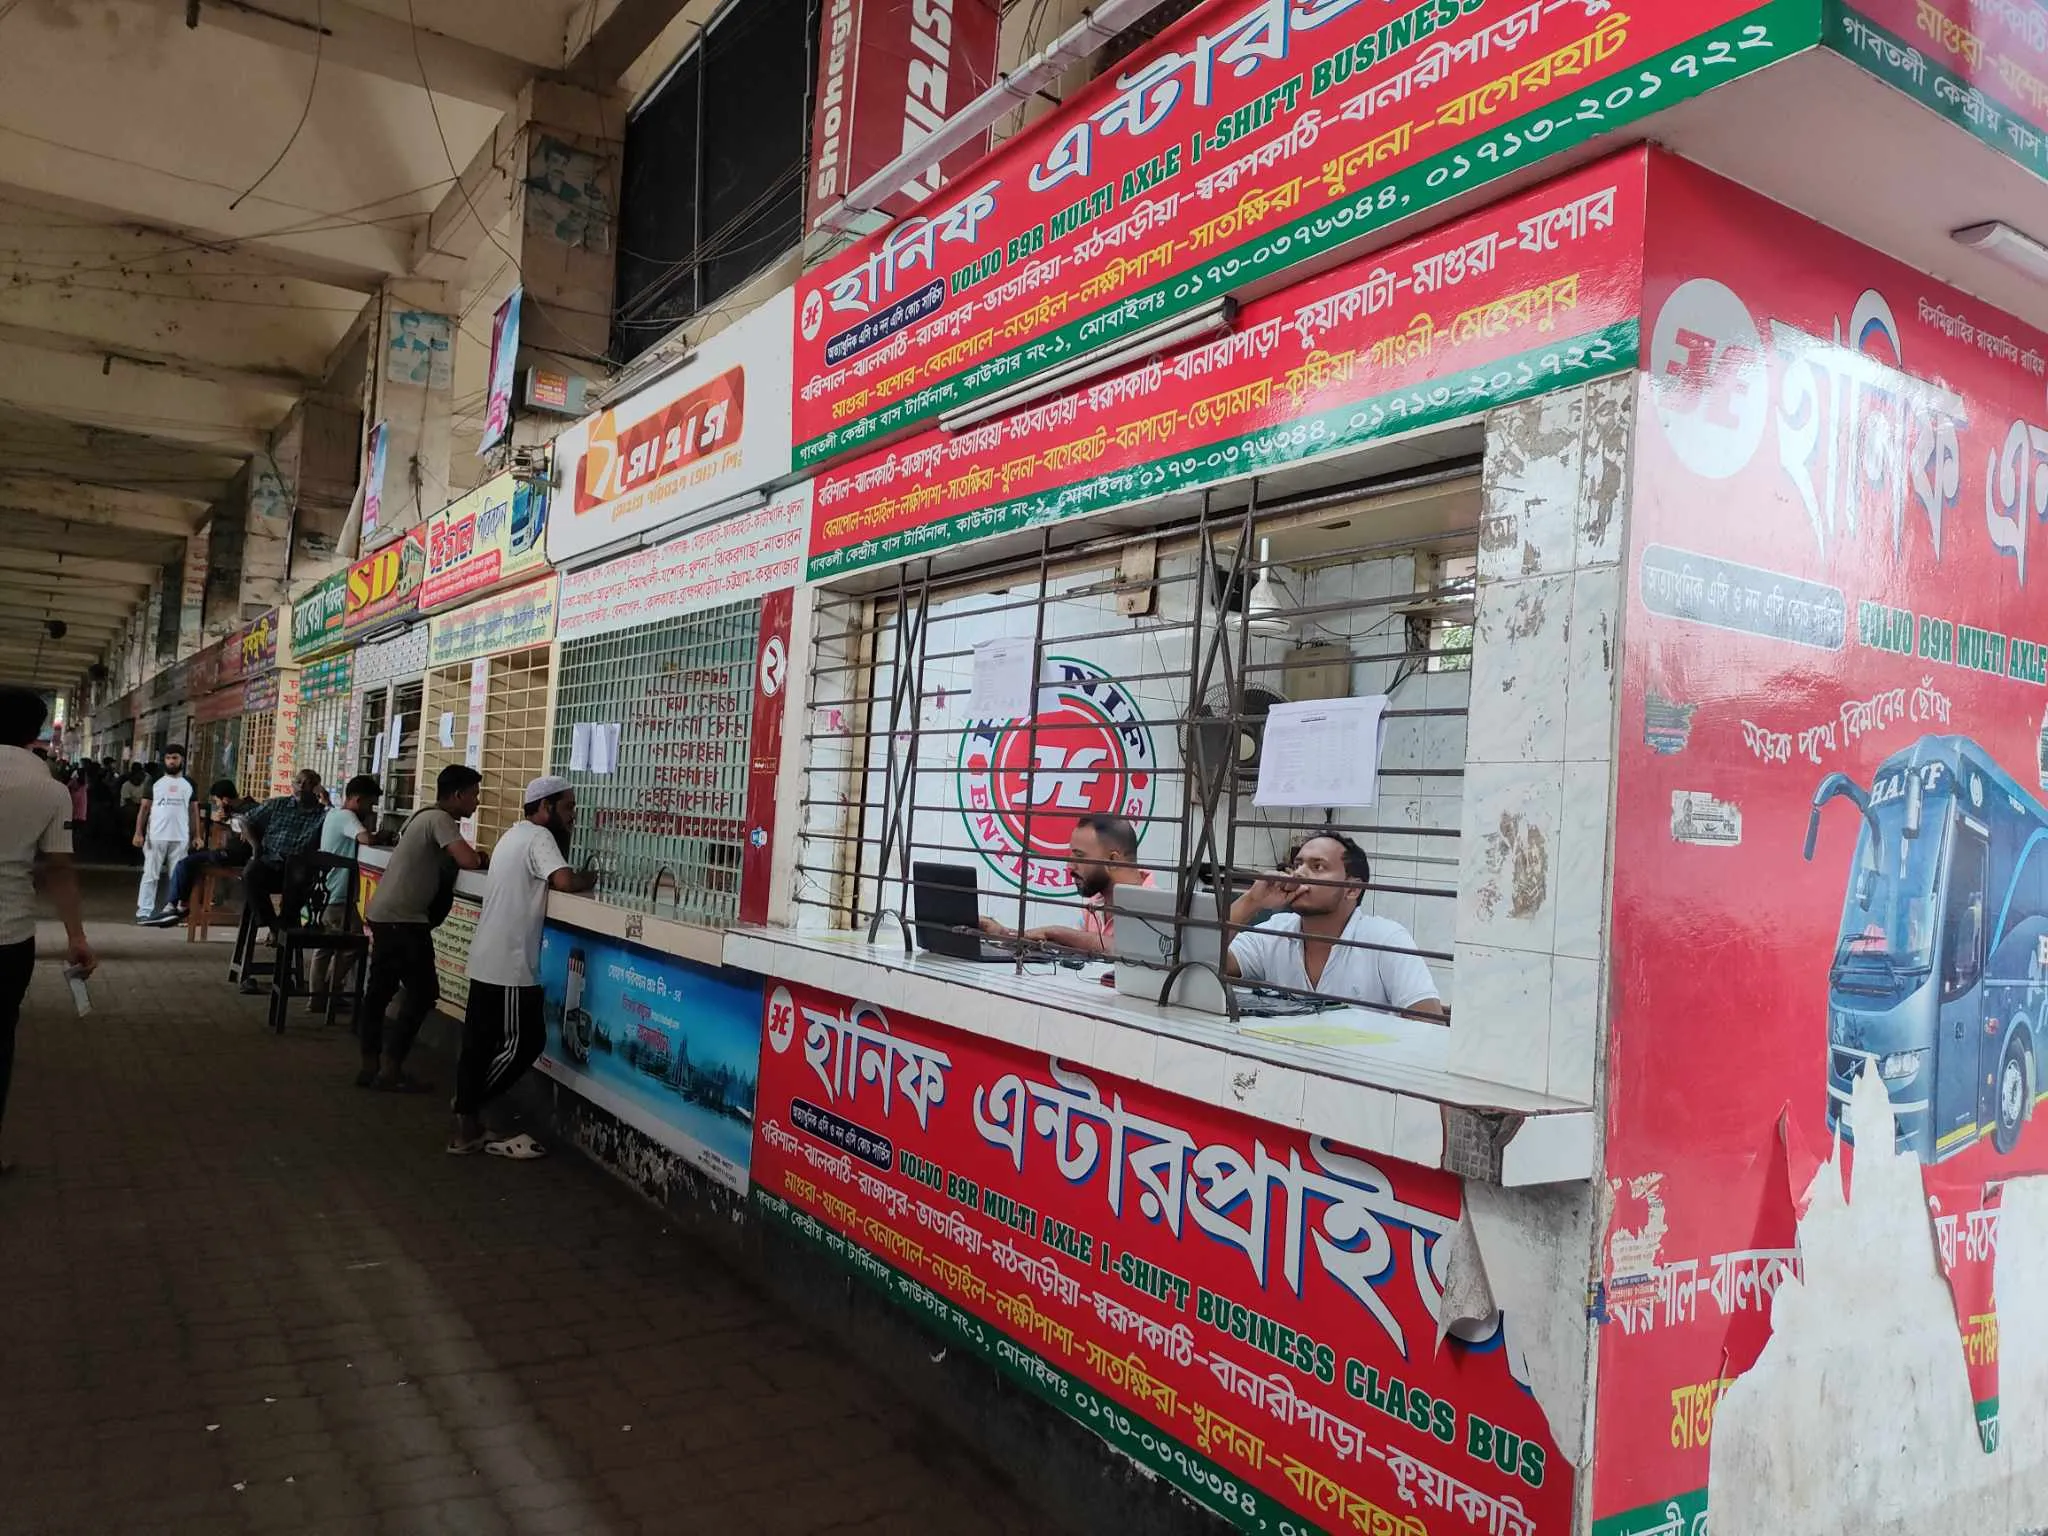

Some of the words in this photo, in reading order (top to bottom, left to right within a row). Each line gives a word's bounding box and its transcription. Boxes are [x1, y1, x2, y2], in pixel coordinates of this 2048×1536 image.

[1435, 12, 1628, 125] বাগেরহাট
[1843, 16, 1928, 86] গাবতলী
[1934, 76, 2001, 133] কেন্দ্রীয়
[2004, 119, 2040, 158] বাস
[825, 180, 1000, 312] হানিফ
[950, 247, 1001, 296] VOLVO
[1006, 223, 1044, 266] B9R
[1049, 182, 1114, 242] MULTI
[1119, 144, 1181, 204] AXLE
[1518, 186, 1616, 252] যশোর
[798, 428, 837, 460] গাবতলী
[840, 410, 876, 444] কেন্দ্রীয়
[879, 400, 901, 425] বাস
[962, 352, 1021, 389] কাউন্টার
[1768, 288, 1968, 565] হানিফ
[347, 550, 400, 615] SD
[1858, 600, 1913, 656] VOLVO
[1918, 616, 1954, 663] B9R
[1957, 623, 2006, 679] MULTI
[801, 1003, 951, 1128] হানিফ
[899, 1149, 942, 1190] VOLVO
[946, 1172, 979, 1209] B9R
[982, 1189, 1036, 1237] MULTI
[1041, 1216, 1093, 1264] AXLE
[1196, 1288, 1335, 1383] BUSINESS
[1344, 1357, 1455, 1444] CLASS
[1467, 1414, 1545, 1488] BUS
